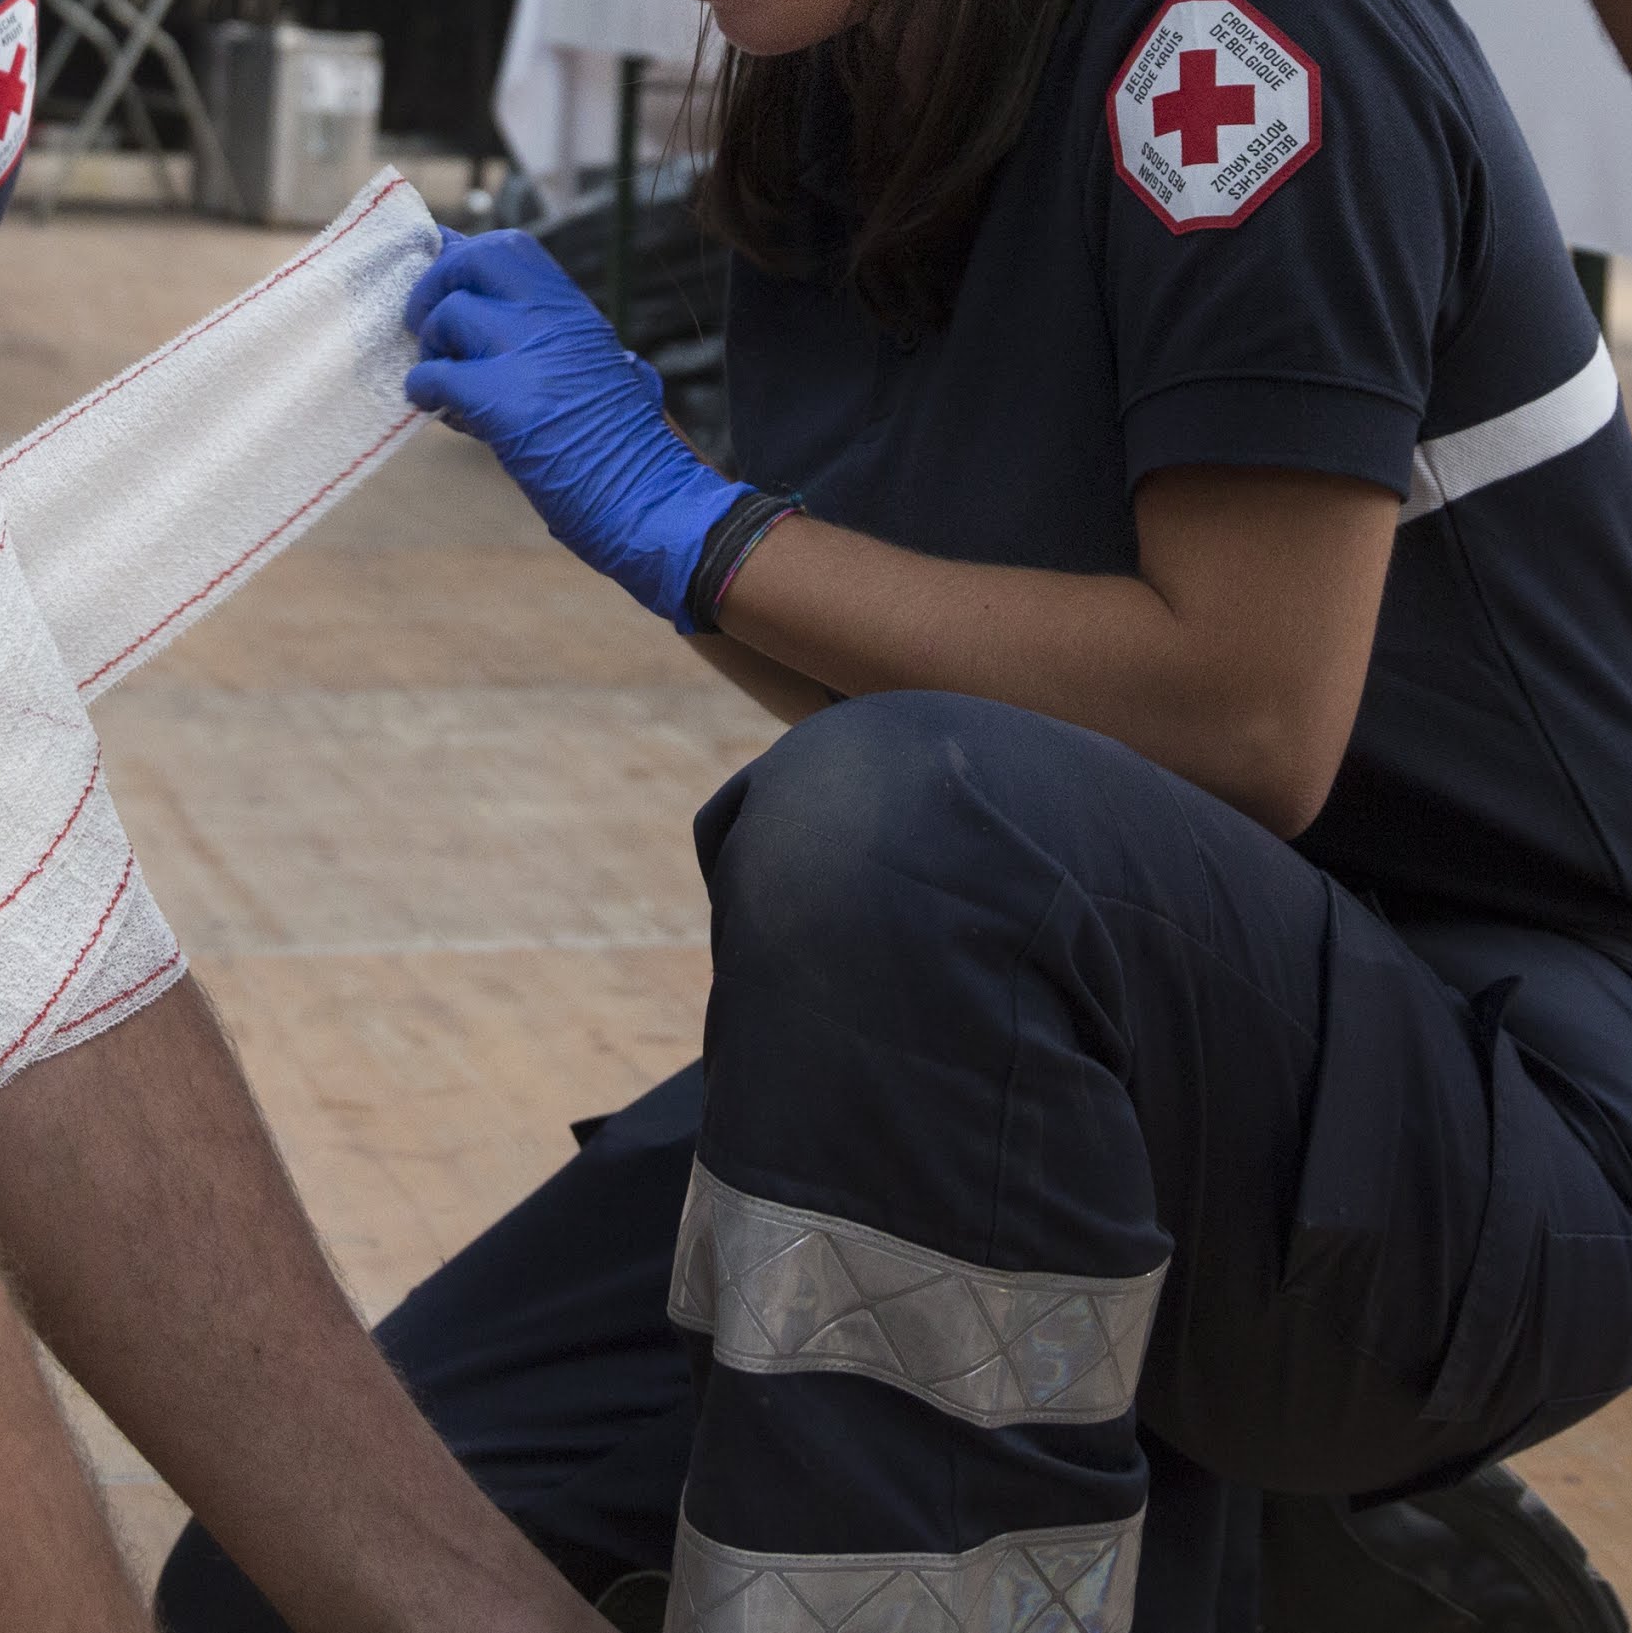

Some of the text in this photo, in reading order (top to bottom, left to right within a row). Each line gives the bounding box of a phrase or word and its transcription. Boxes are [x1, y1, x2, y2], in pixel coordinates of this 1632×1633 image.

[1125, 25, 1171, 95] BELGISCHE
[1134, 31, 1184, 105] RODE KRUIS
[1209, 24, 1285, 92] DE BELGIQUE
[1220, 11, 1299, 80] CROIX-ROUGE
[1139, 162, 1172, 205] BELGIAN
[1141, 141, 1187, 193] RED CROSS
[1211, 119, 1288, 194] ROTES KREUZ
[1228, 134, 1298, 200] BELGISCHES
